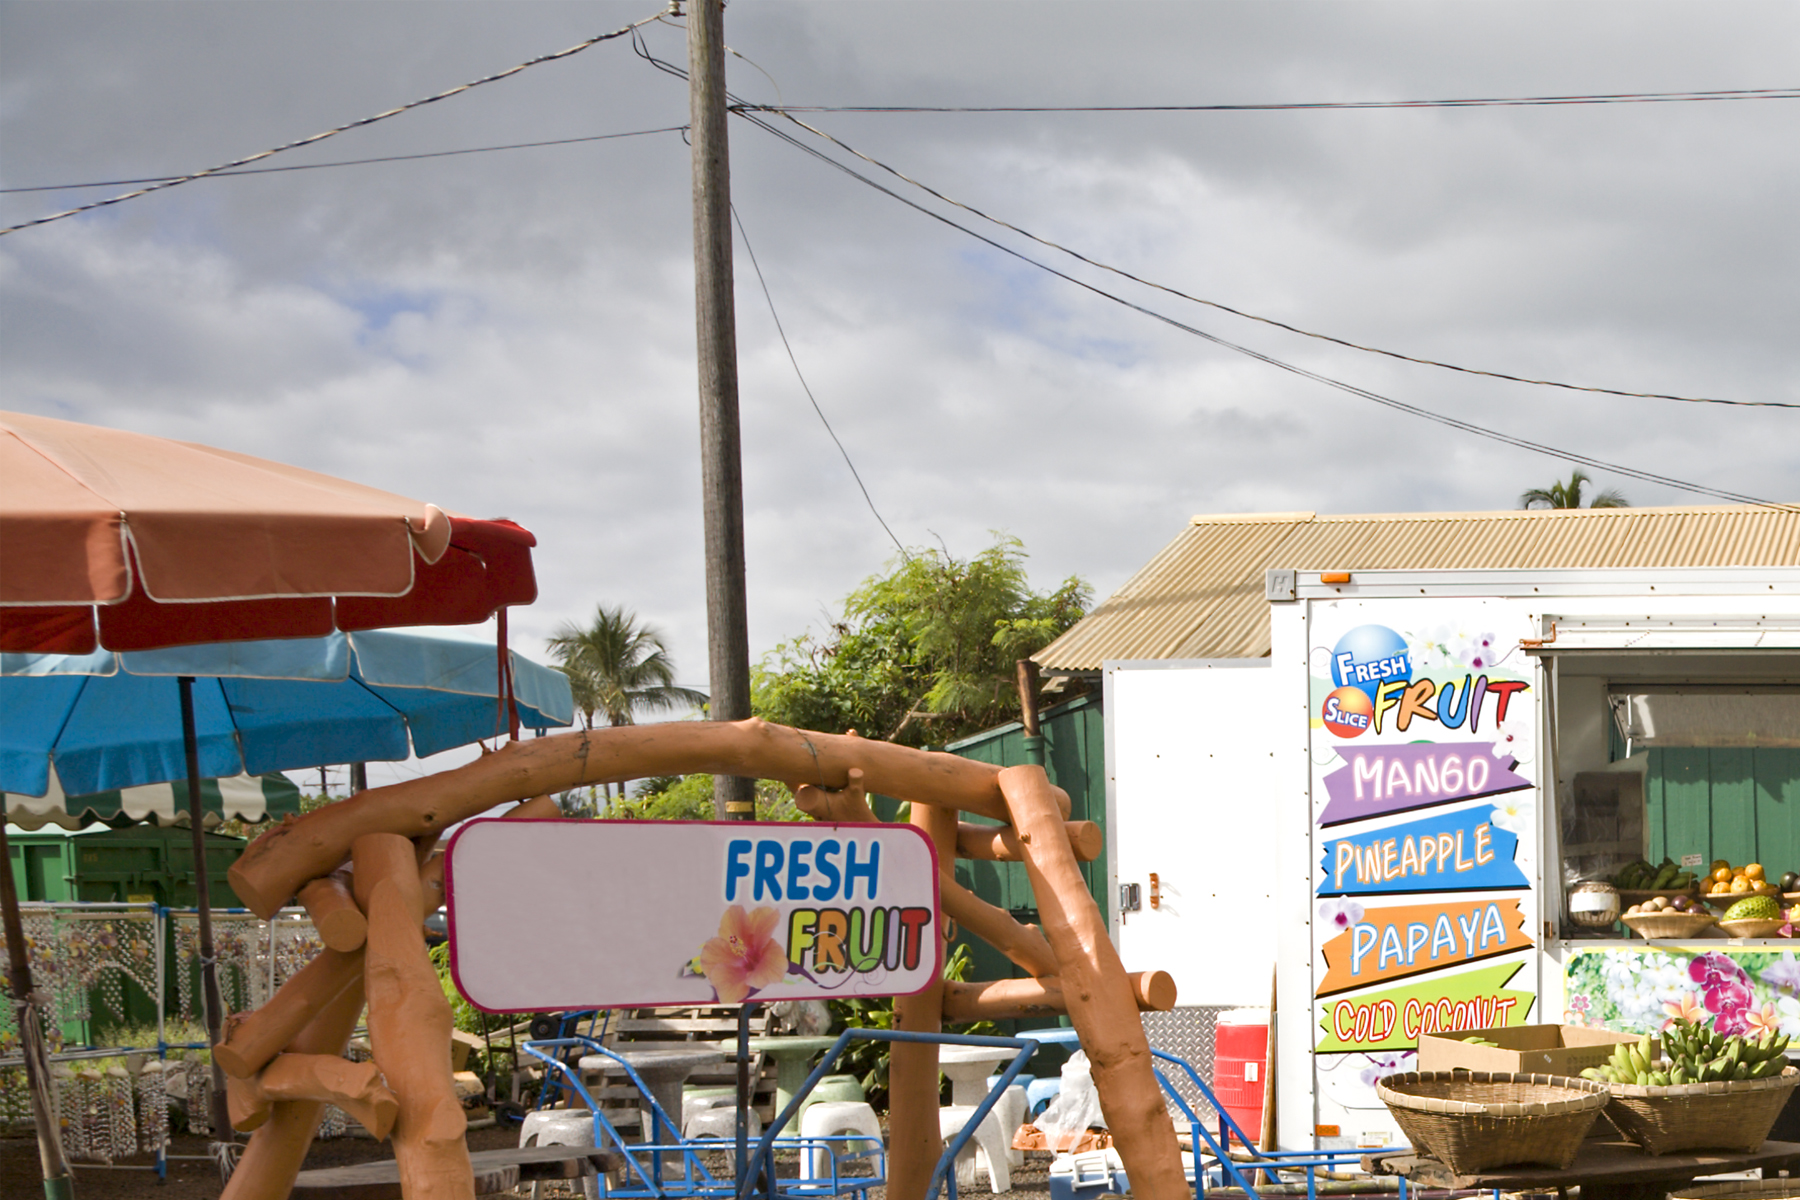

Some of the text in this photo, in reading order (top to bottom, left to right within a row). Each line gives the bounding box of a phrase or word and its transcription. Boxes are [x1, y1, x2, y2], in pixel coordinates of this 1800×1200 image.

[1373, 673, 1530, 735] FRUIT
[1352, 753, 1491, 802] MANGO
[724, 839, 881, 903] FRESH
[1333, 822, 1495, 890] PINEAPPLE
[786, 907, 932, 974] FRUIT
[1350, 902, 1508, 977] PAPAYA
[1332, 996, 1518, 1044] COLD COCONUT
